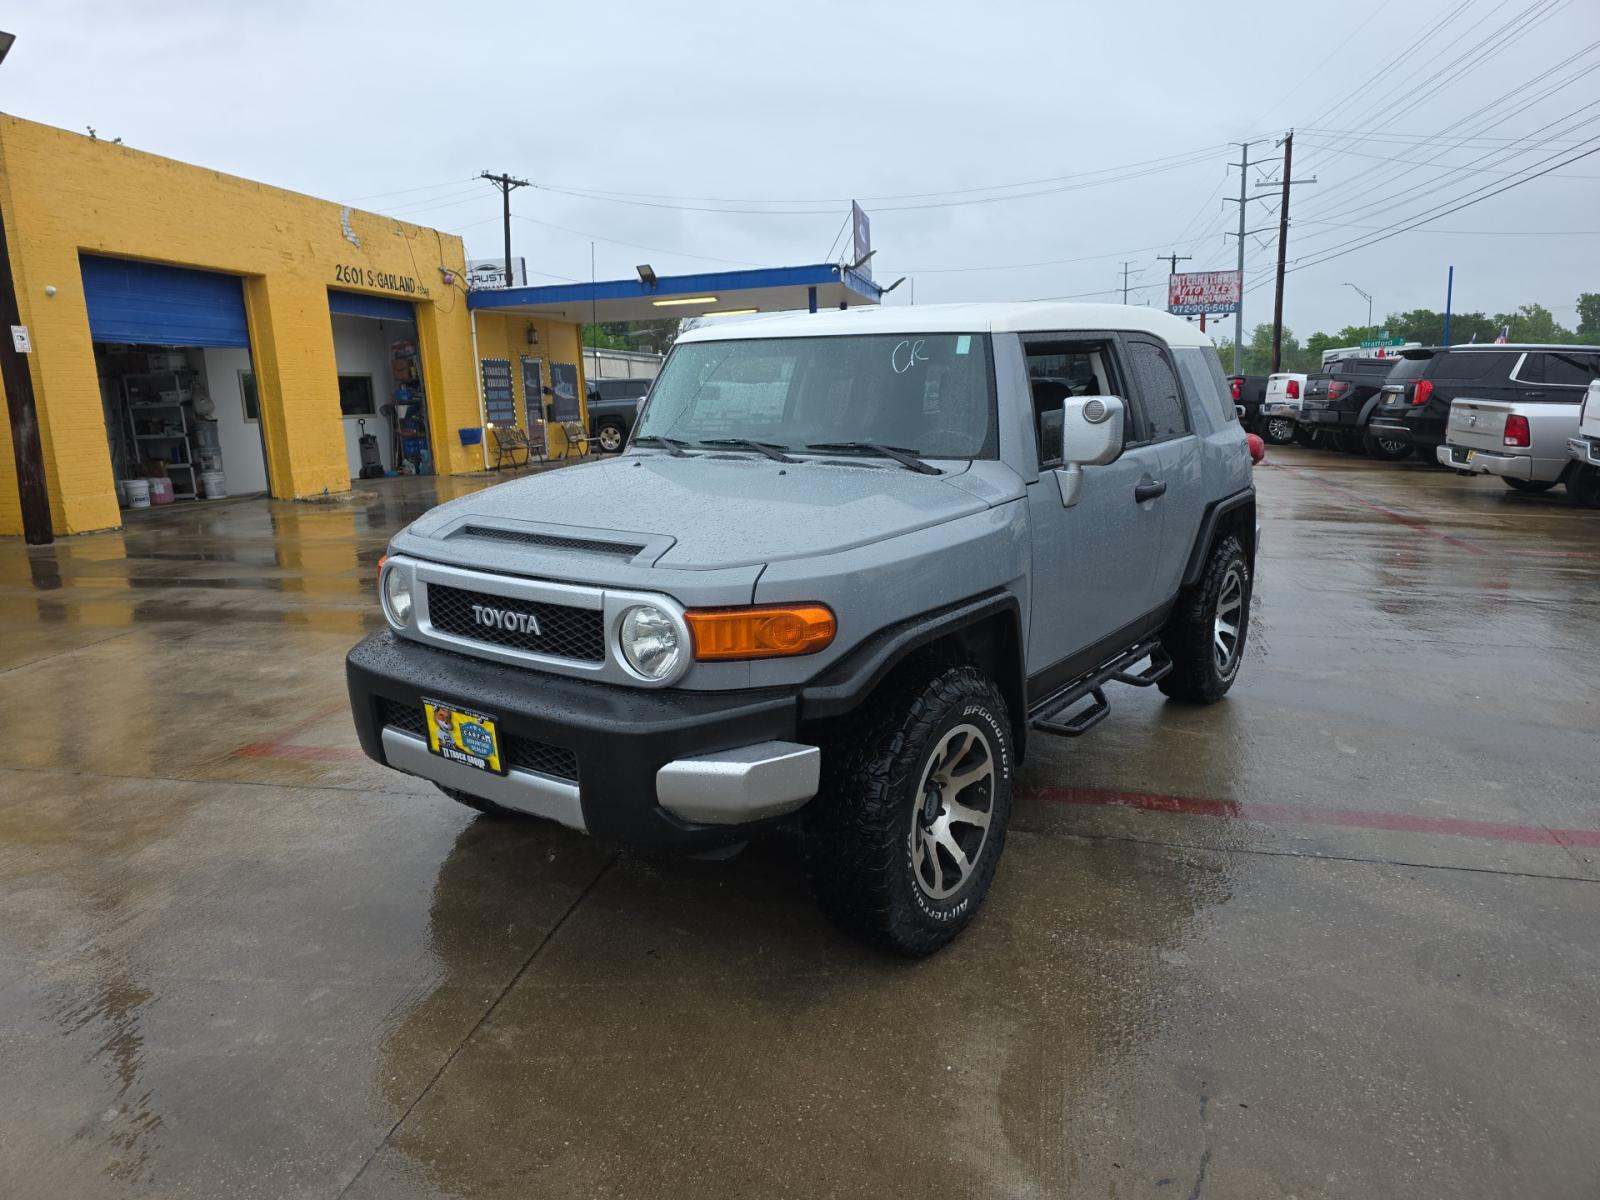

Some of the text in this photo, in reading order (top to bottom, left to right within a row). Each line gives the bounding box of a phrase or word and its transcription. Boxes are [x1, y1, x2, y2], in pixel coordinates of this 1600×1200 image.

[336, 264, 363, 286] 2601
[1175, 283, 1202, 295] AUTO
[1361, 340, 1393, 348] Stratford
[472, 605, 541, 636] TOYOTA
[963, 705, 1009, 779] BFGoodrich
